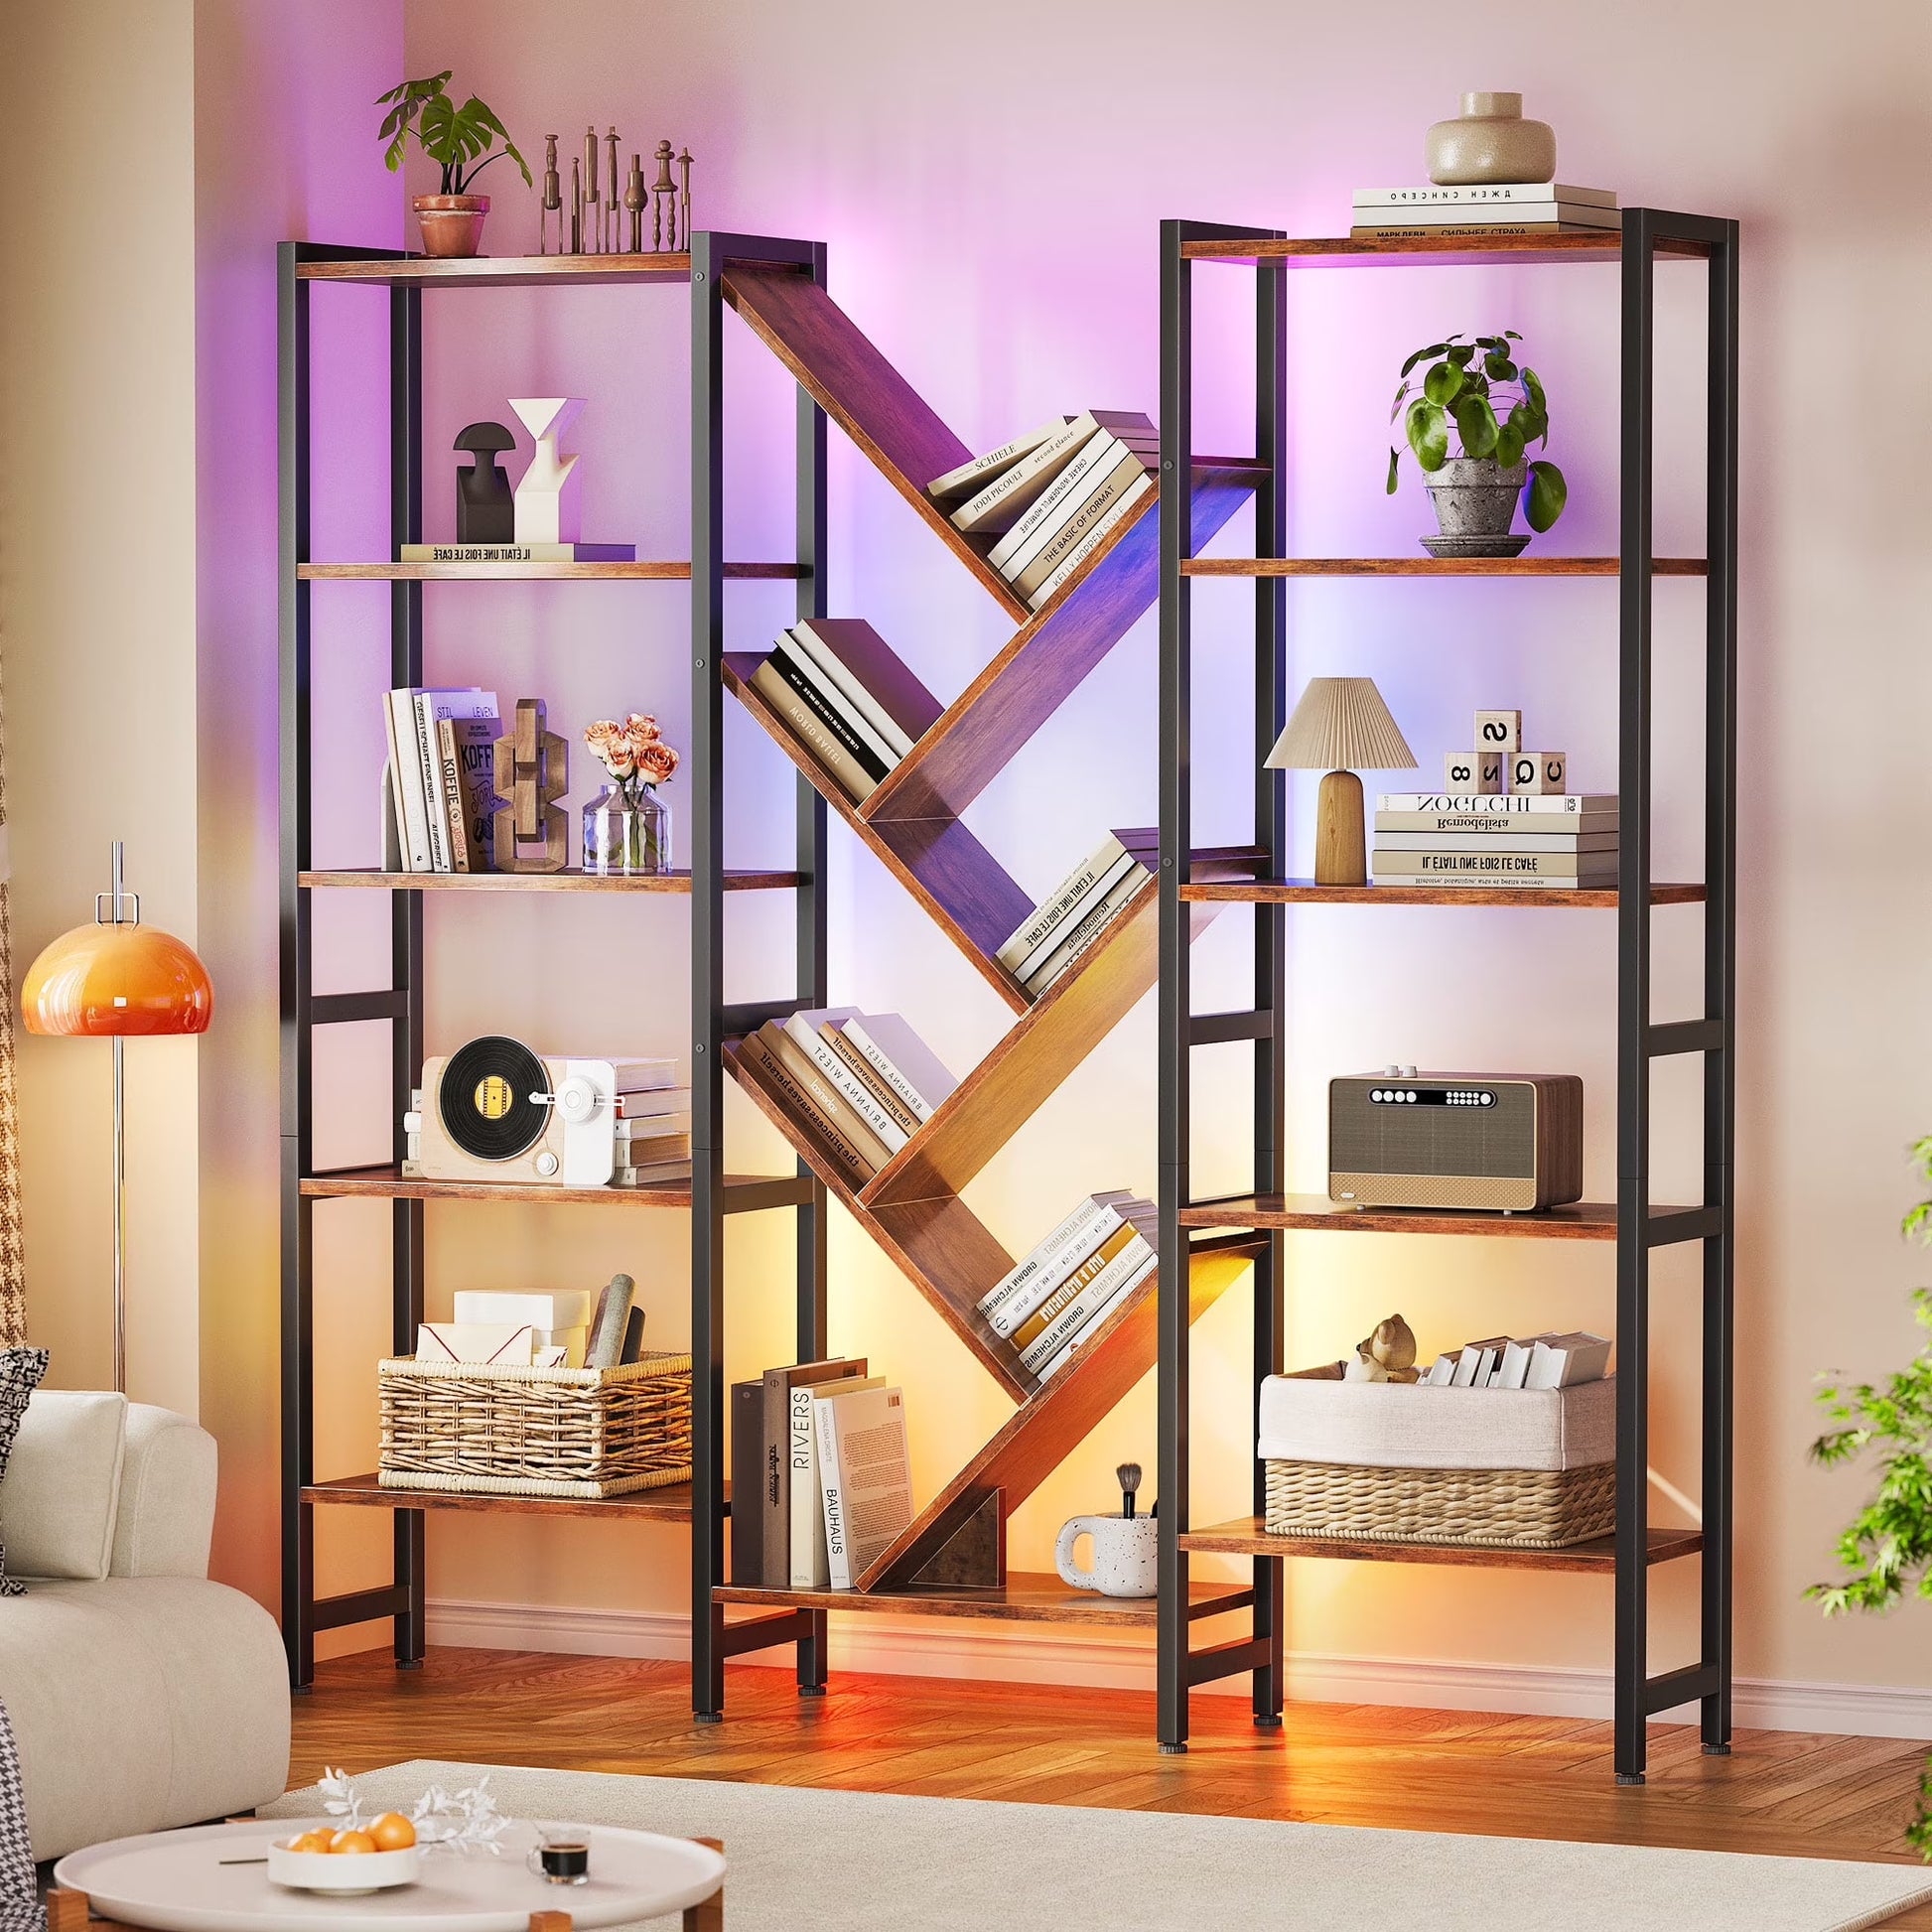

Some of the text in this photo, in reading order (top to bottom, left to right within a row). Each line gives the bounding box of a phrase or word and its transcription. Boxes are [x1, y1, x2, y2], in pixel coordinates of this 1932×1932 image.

[975, 445, 1017, 471] SCHIELE
[1067, 459, 1088, 481] CREATE
[973, 494, 992, 513] JODI
[990, 470, 1025, 499] PICOULT
[1043, 484, 1115, 564] THE BASIC OF FORMAT
[437, 706, 493, 718] STIL LEVEN
[443, 759, 460, 805] KOFFIE
[1451, 765, 1470, 781] 8
[1547, 761, 1562, 782] C
[793, 1393, 809, 1468] RIVERS
[826, 1489, 843, 1554] BAUHAUS
